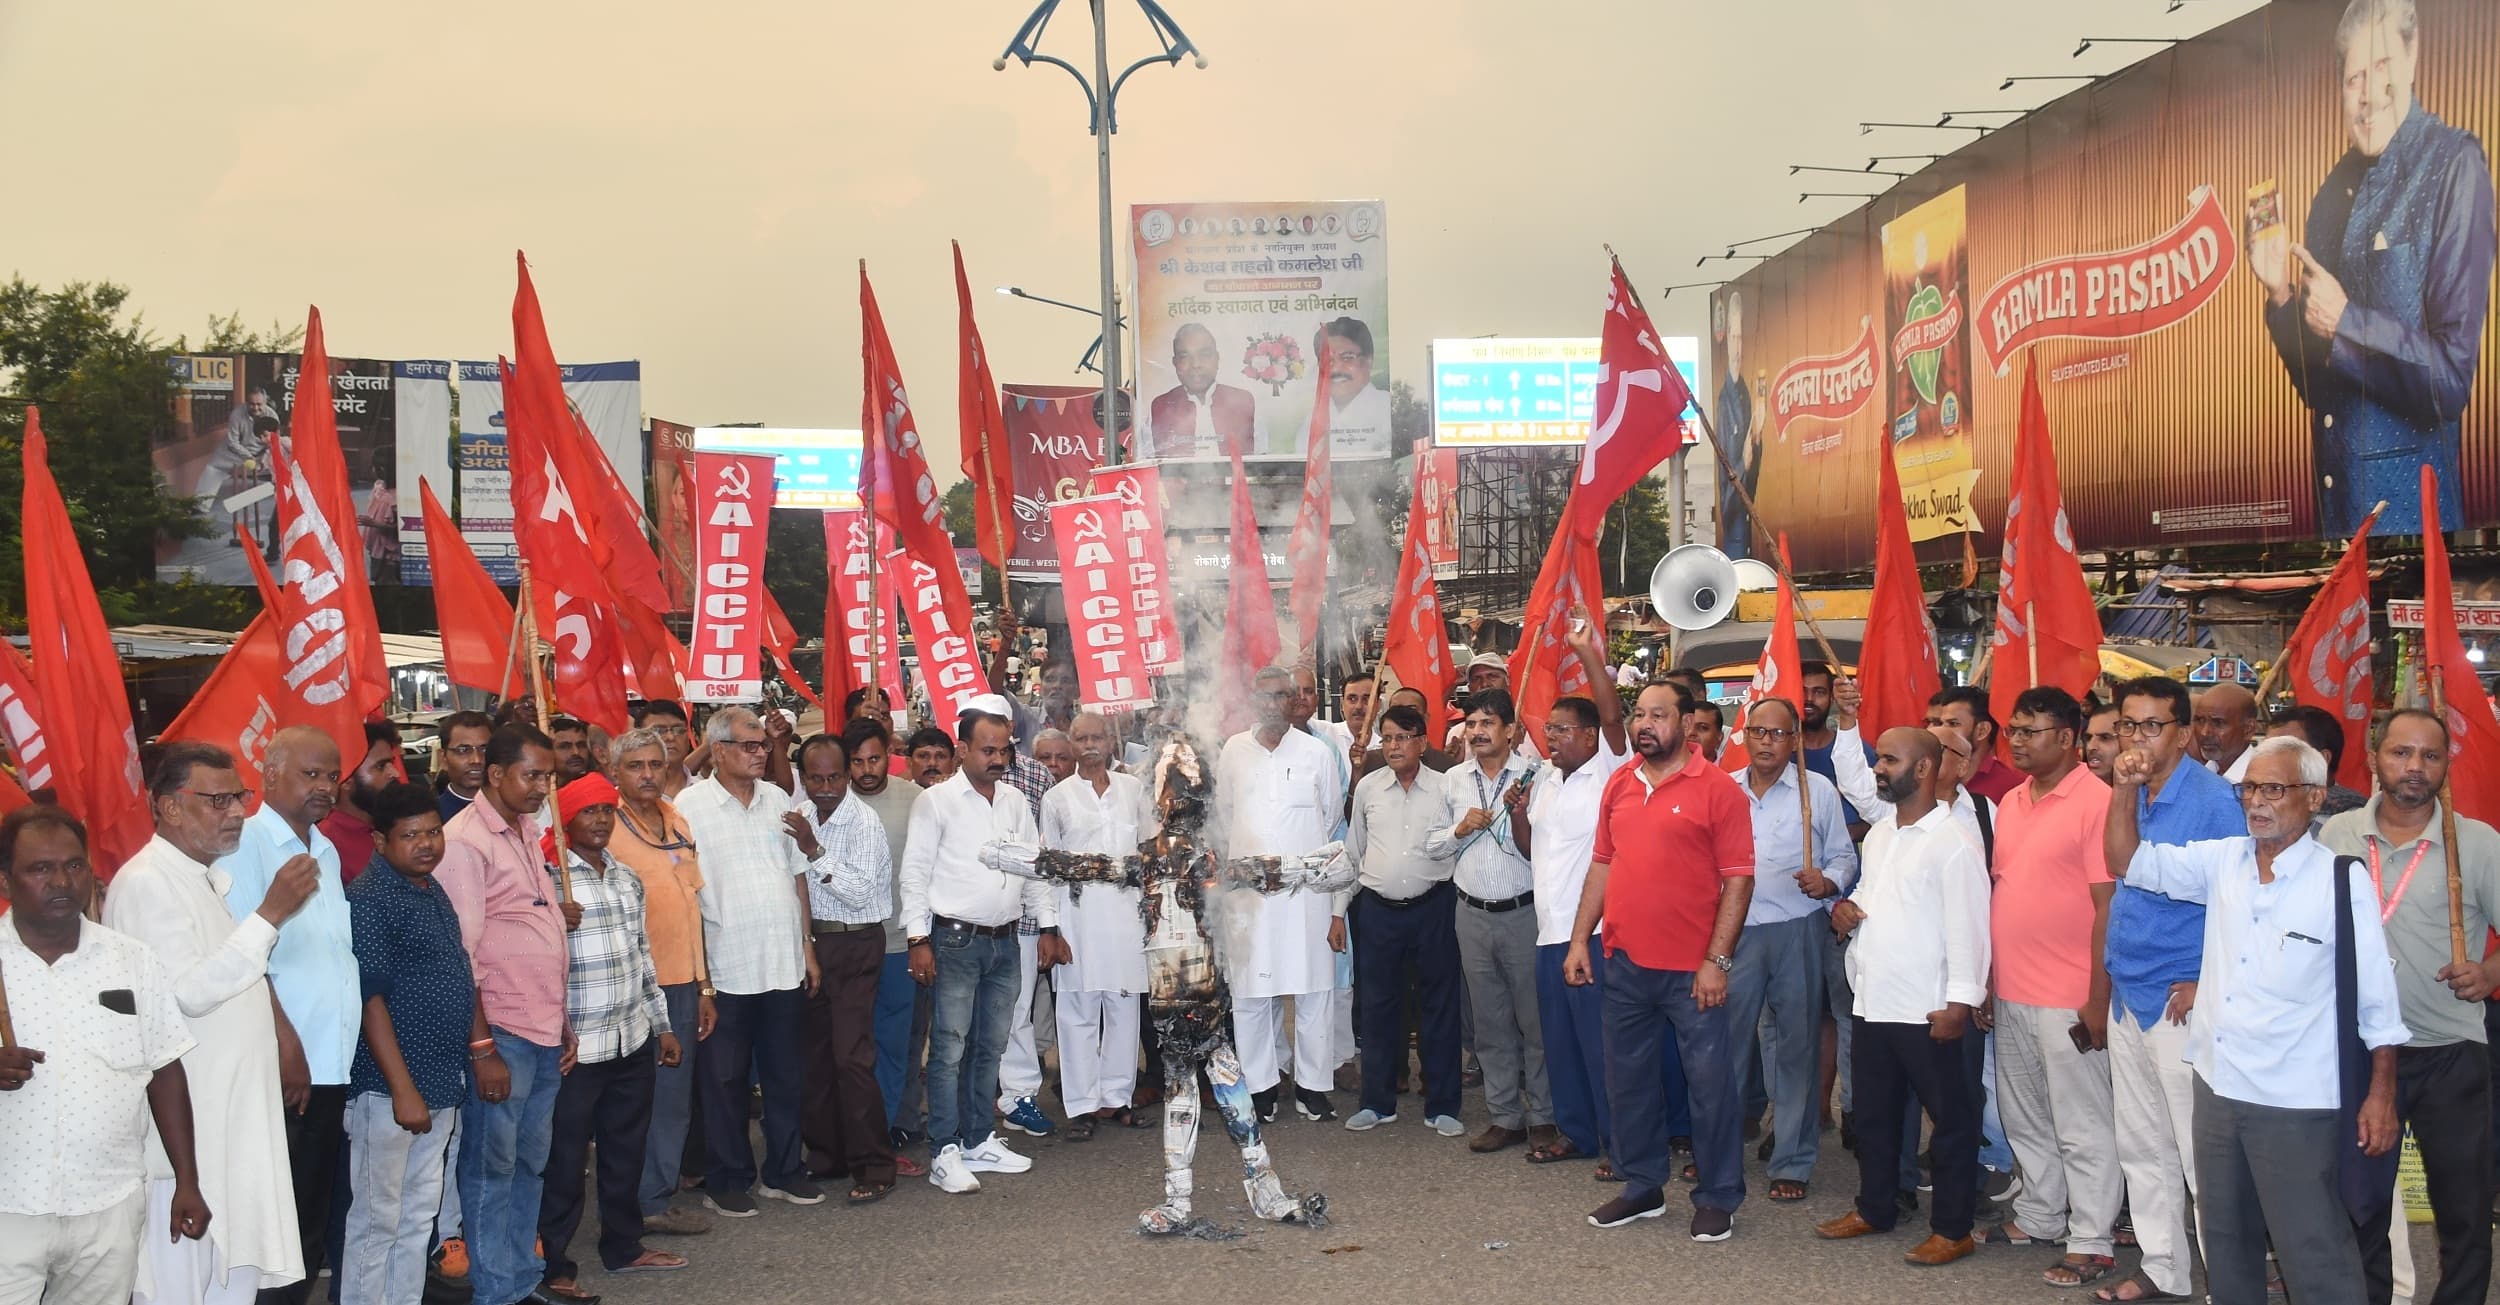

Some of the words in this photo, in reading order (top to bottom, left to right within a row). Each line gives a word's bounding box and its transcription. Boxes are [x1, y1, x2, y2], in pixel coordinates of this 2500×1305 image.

[1278, 254, 1337, 272] कमलेश
[1342, 252, 1363, 270] जी
[1991, 267, 2077, 353] KAMLA
[2085, 225, 2218, 318] PASAND
[1168, 296, 1211, 318] हार्दिक
[1217, 298, 1264, 314] स्वागत
[1269, 296, 1288, 314] एवं
[1294, 294, 1358, 312] अभिनंदन
[1896, 325, 1921, 360] KAMLA
[1923, 306, 1958, 343] PASAND
[196, 361, 228, 379] LIC
[337, 370, 389, 390] खेलता
[406, 362, 432, 374] हमारे
[1777, 368, 1821, 414] कमला
[1822, 347, 1873, 405] पसन्द
[2051, 364, 2073, 382] SILVER
[2073, 358, 2100, 377] COATED
[2101, 352, 2129, 373] ELAICHI
[1028, 432, 1096, 461] MBA
[1930, 486, 1965, 519] Swad
[707, 501, 753, 680] AICCTU
[1123, 509, 1167, 663] AICCTU
[844, 553, 886, 684] AICCT
[1075, 542, 1134, 700] AICCTU
[917, 584, 978, 735] AICCT
[706, 683, 740, 698] CSW
